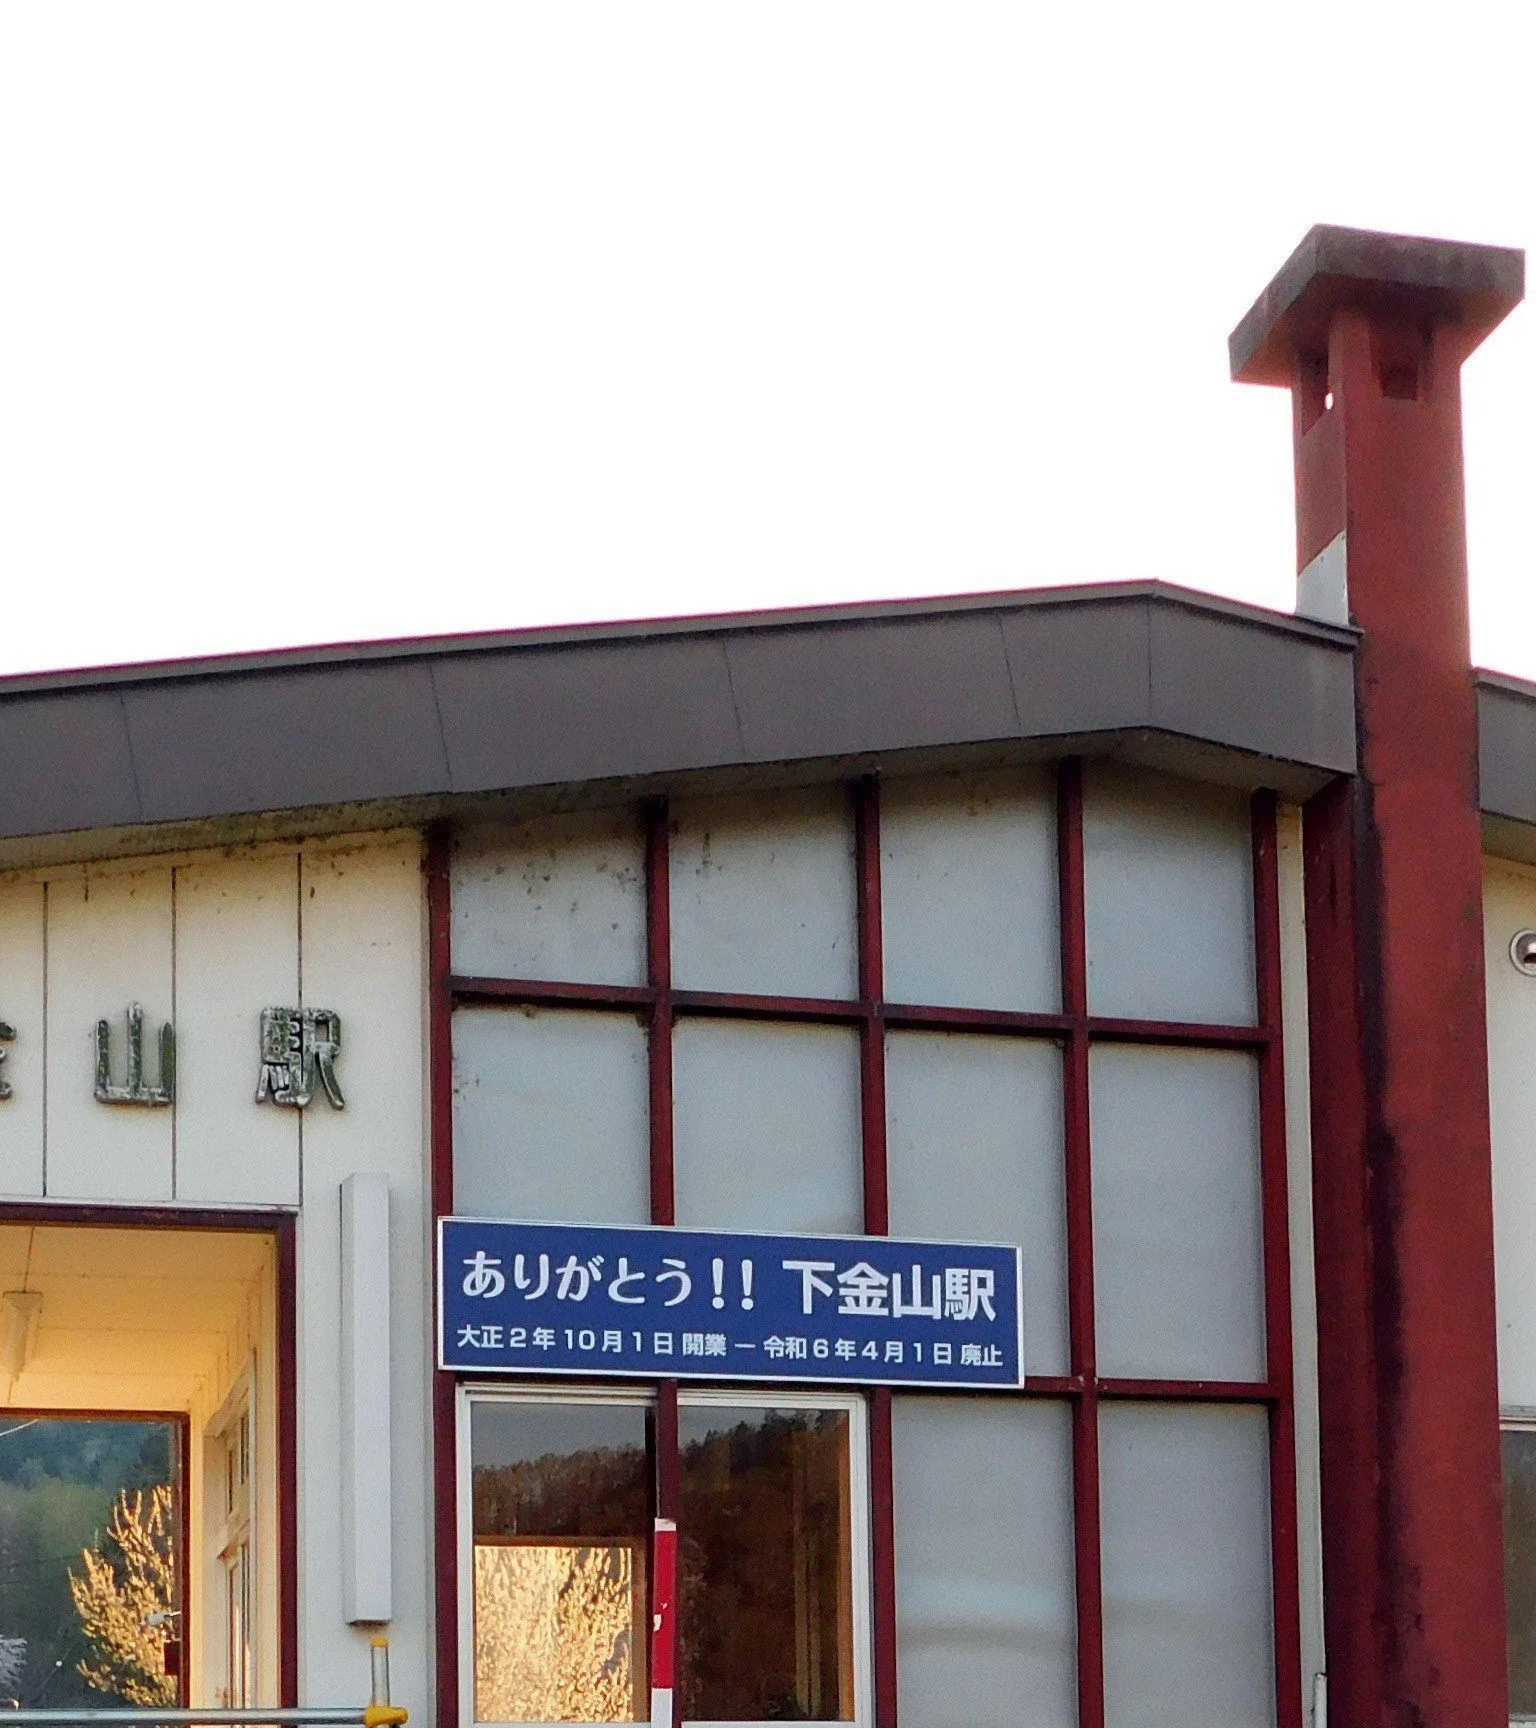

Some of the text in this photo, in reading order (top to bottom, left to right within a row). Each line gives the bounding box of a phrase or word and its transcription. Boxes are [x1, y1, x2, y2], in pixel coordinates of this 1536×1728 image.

[462, 1250, 997, 1323] ありがとう!! 下金山駅
